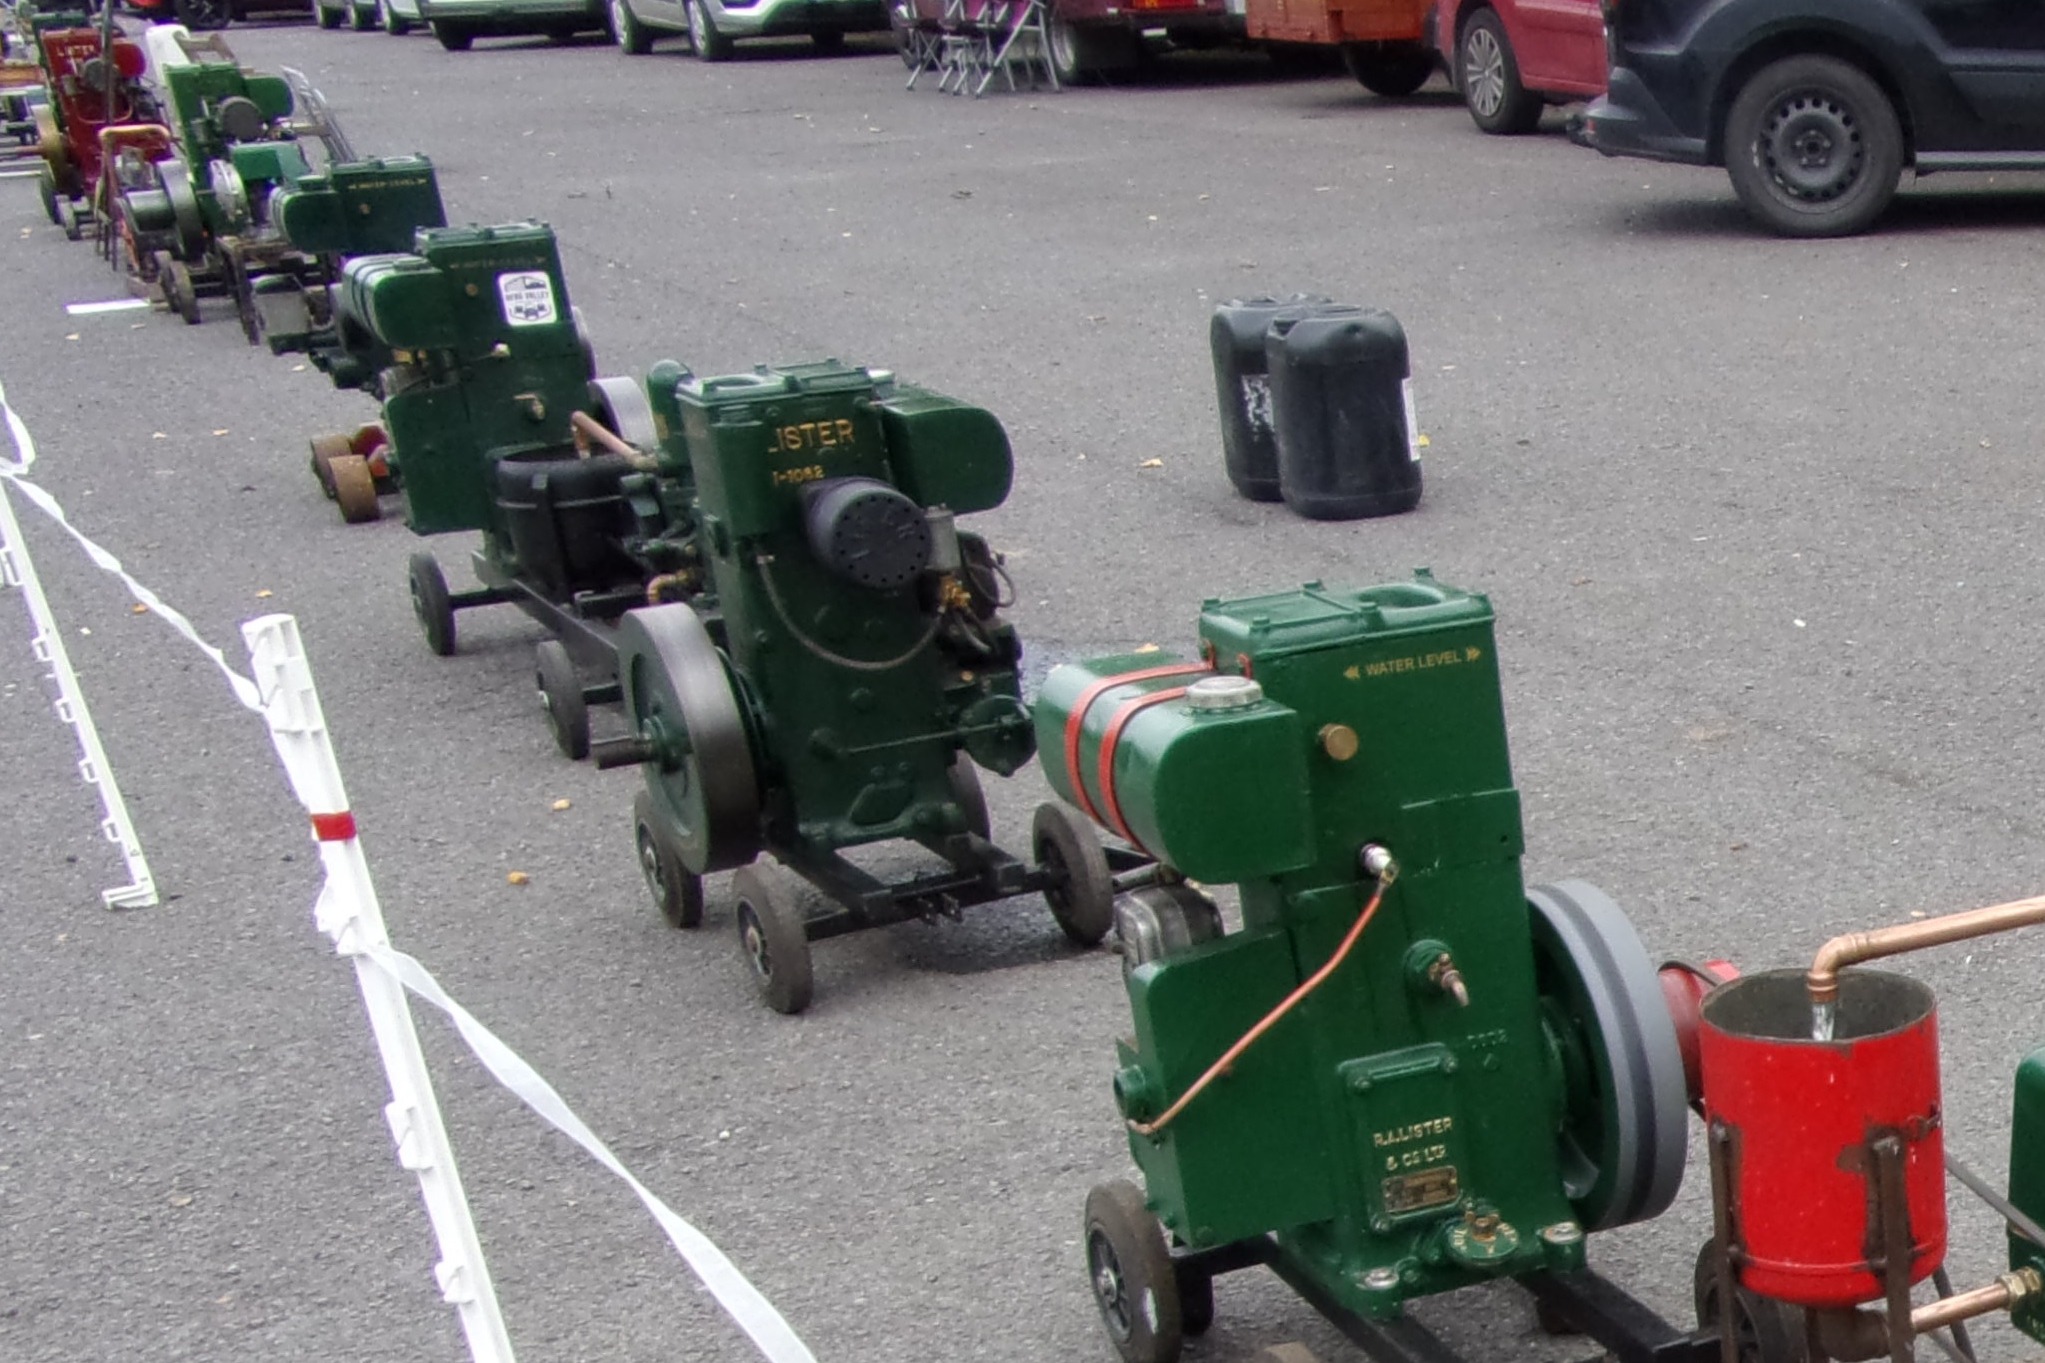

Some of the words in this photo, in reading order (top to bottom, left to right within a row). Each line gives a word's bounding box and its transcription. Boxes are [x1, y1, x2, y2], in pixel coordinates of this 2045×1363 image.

[1365, 657, 1415, 676] WATER
[1418, 650, 1462, 668] LEVEL
[1386, 1156, 1398, 1171] &
